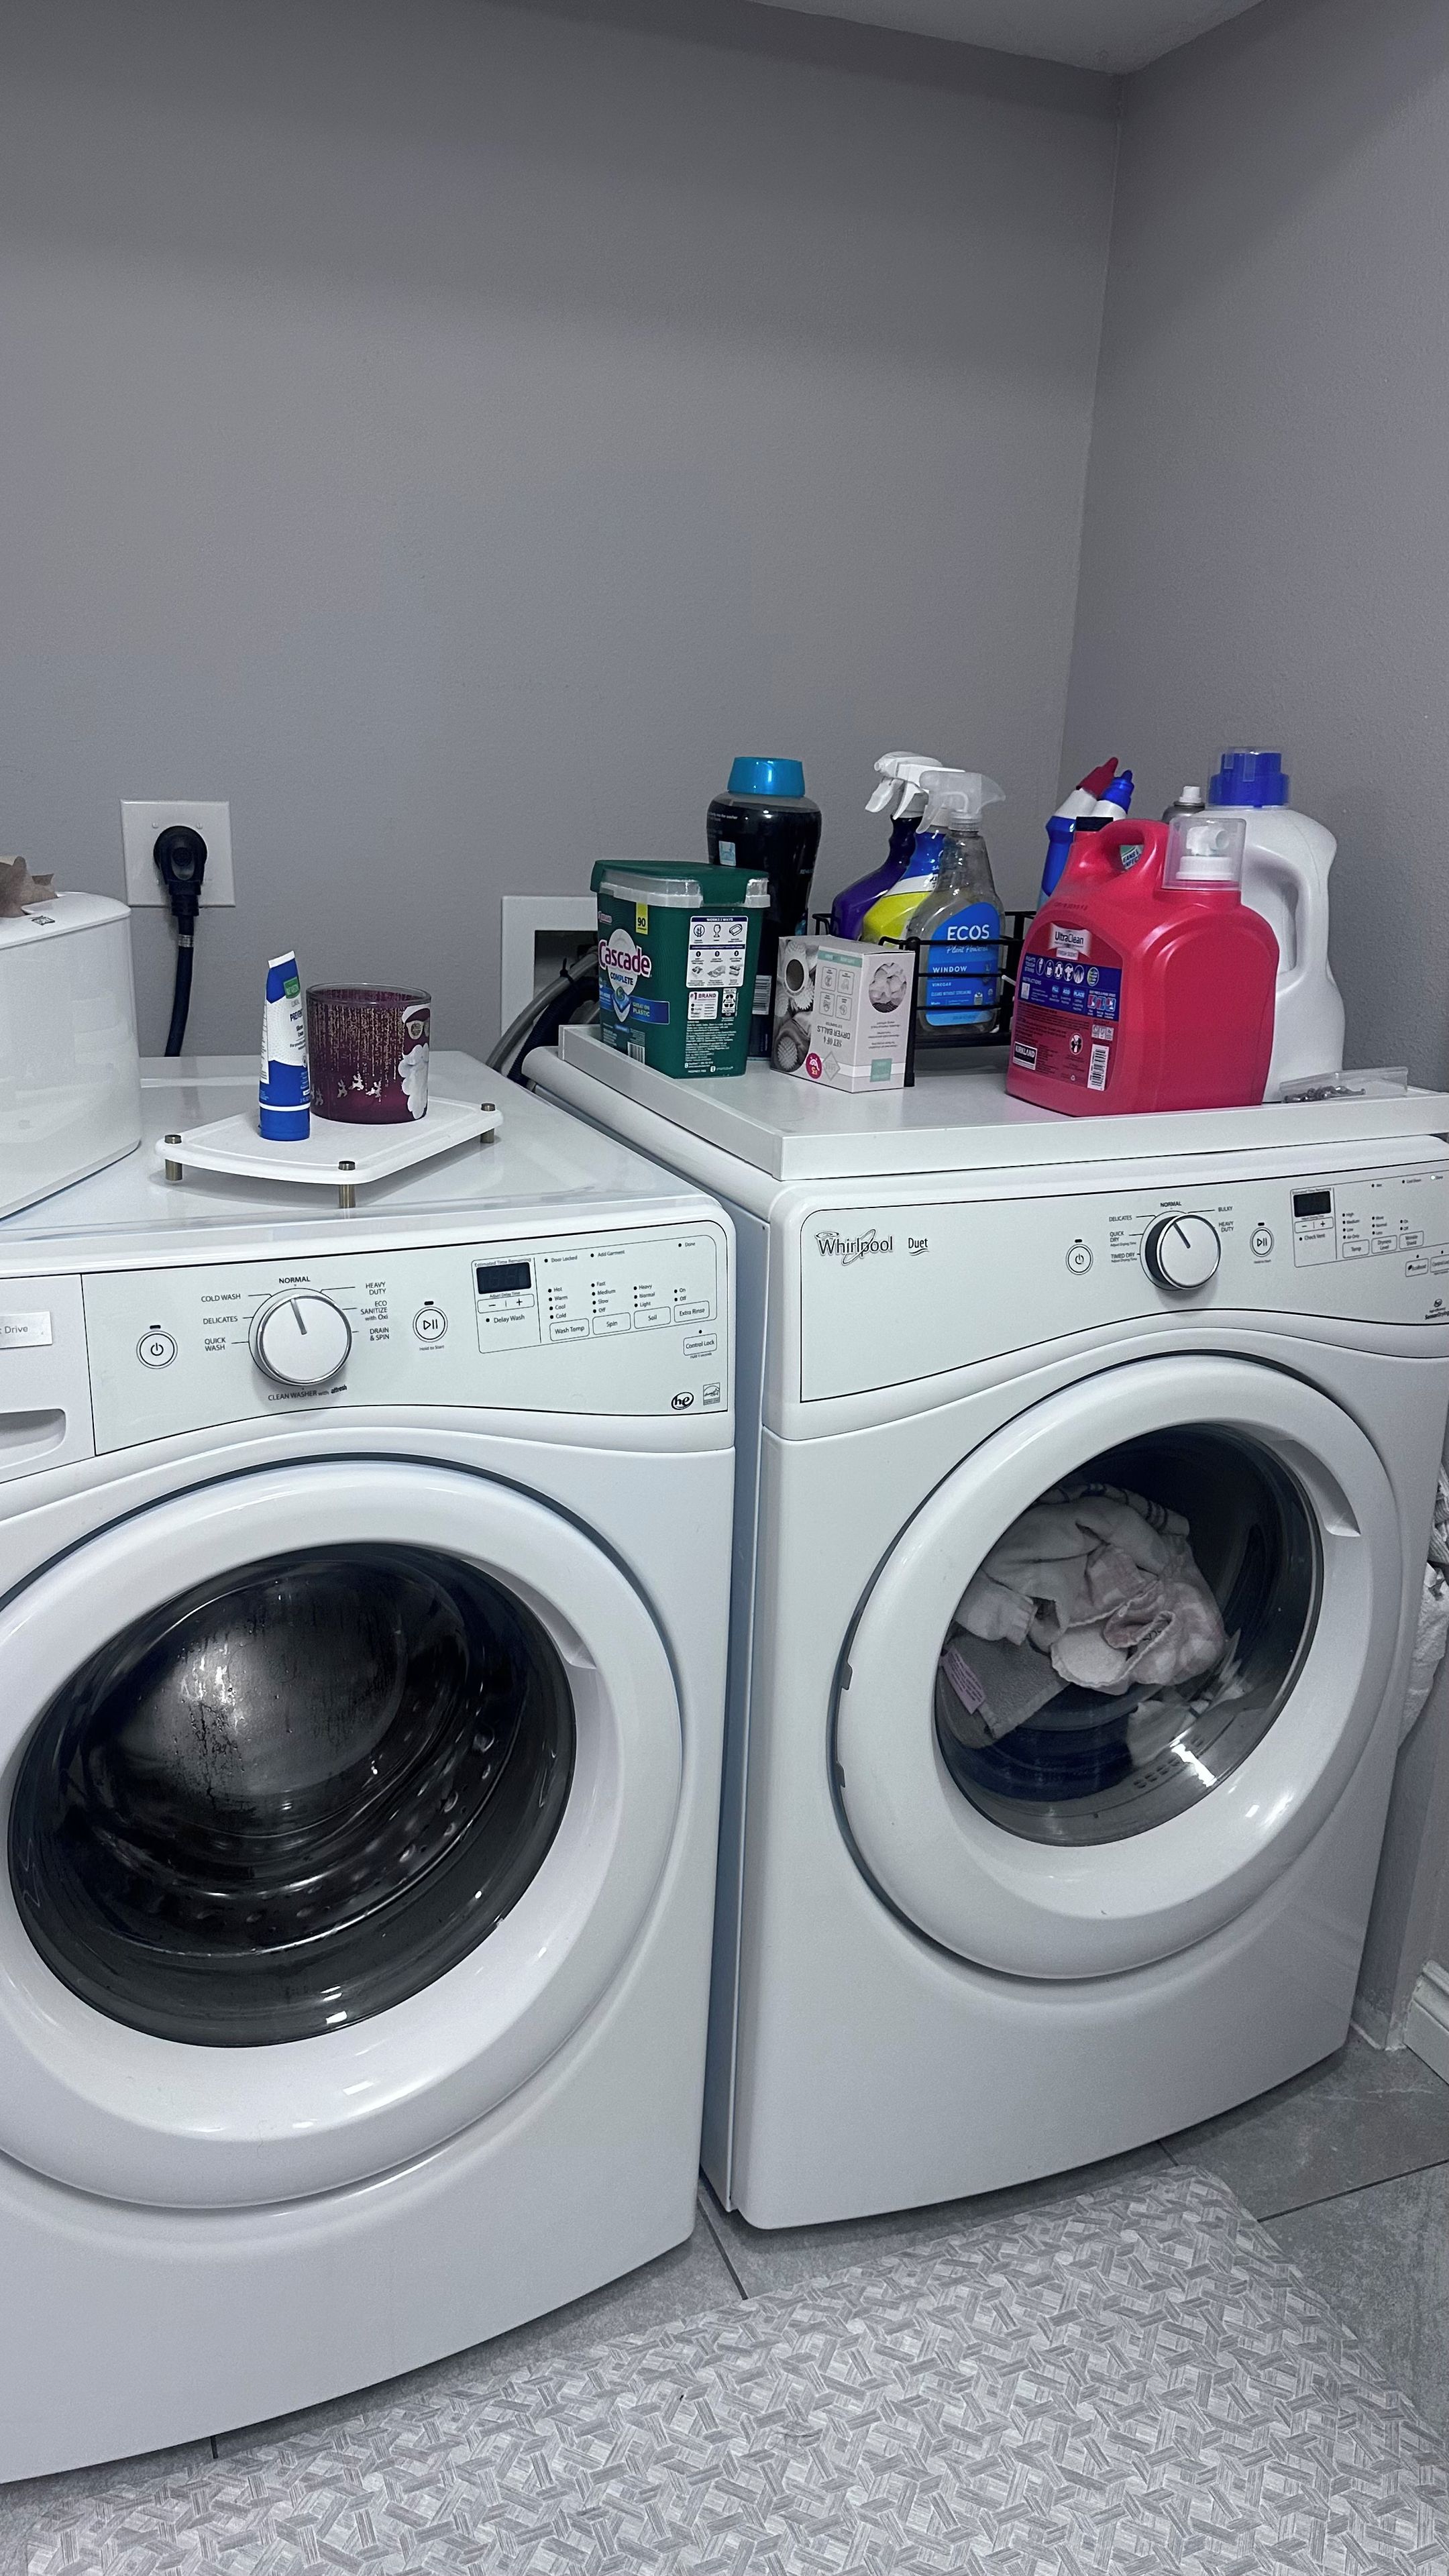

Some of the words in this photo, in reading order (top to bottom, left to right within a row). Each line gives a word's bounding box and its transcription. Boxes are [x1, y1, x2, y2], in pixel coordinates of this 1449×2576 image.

[638, 917, 645, 927] 90
[947, 924, 989, 940] ECOS
[1055, 932, 1083, 945] UltraClean
[946, 945, 964, 954] Plant
[598, 941, 651, 976] Cascade
[610, 972, 634, 985] COMPLETE
[633, 1009, 650, 1017] PLASTIC
[817, 1025, 833, 1036] BALLS
[834, 1028, 851, 1040] DRYER
[826, 1038, 833, 1046] OF
[833, 1040, 842, 1048] SET
[816, 1235, 894, 1257] Whirlpool
[908, 1237, 928, 1248] Duet
[361, 1307, 387, 1315] SANITIZE
[203, 1316, 237, 1324] DELICATES
[5, 1326, 28, 1334] Drive
[570, 1325, 584, 1333] Temp
[205, 1337, 225, 1345] QUICK
[290, 1390, 317, 1398] WASHER
[673, 1394, 692, 1407] he
